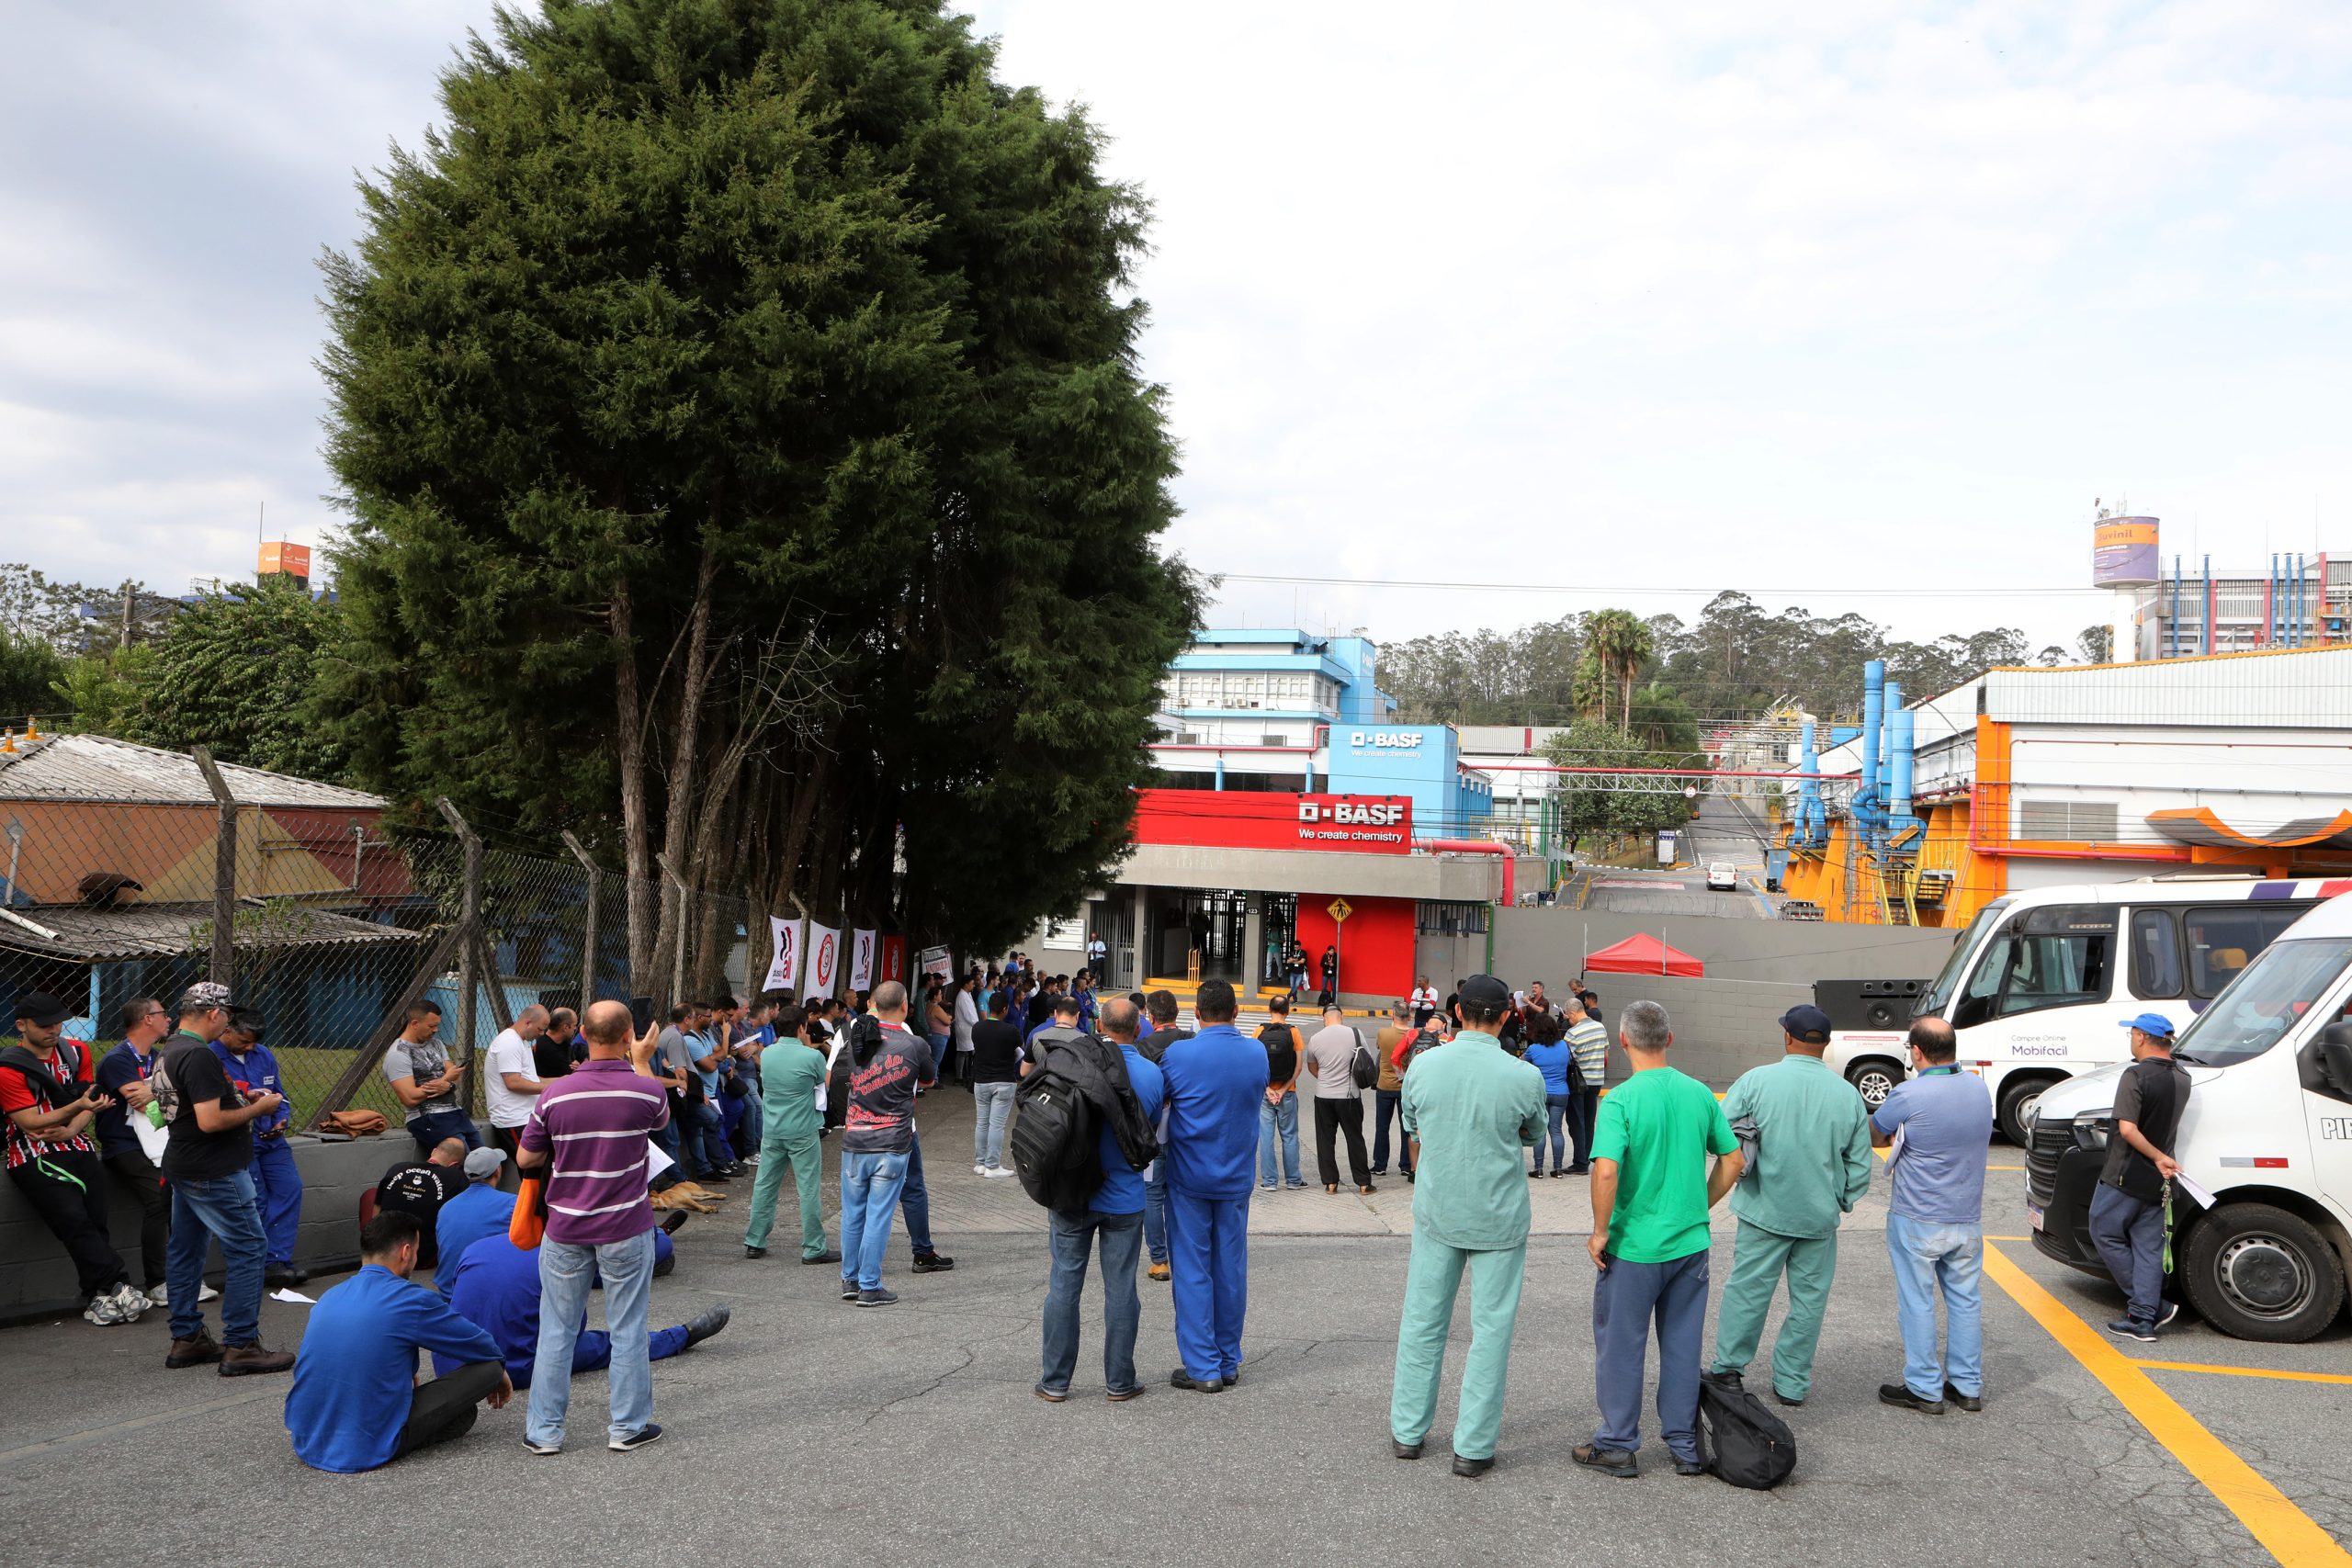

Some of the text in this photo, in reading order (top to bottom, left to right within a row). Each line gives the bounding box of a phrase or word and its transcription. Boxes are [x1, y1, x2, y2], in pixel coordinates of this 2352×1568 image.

[1375, 733, 1422, 748] BASF
[1351, 749, 1362, 757] We
[1335, 803, 1403, 825] BASF
[1299, 829, 1403, 843] We create chemistry
[2011, 1034, 2041, 1043] Compre
[406, 1168, 431, 1176] ocean
